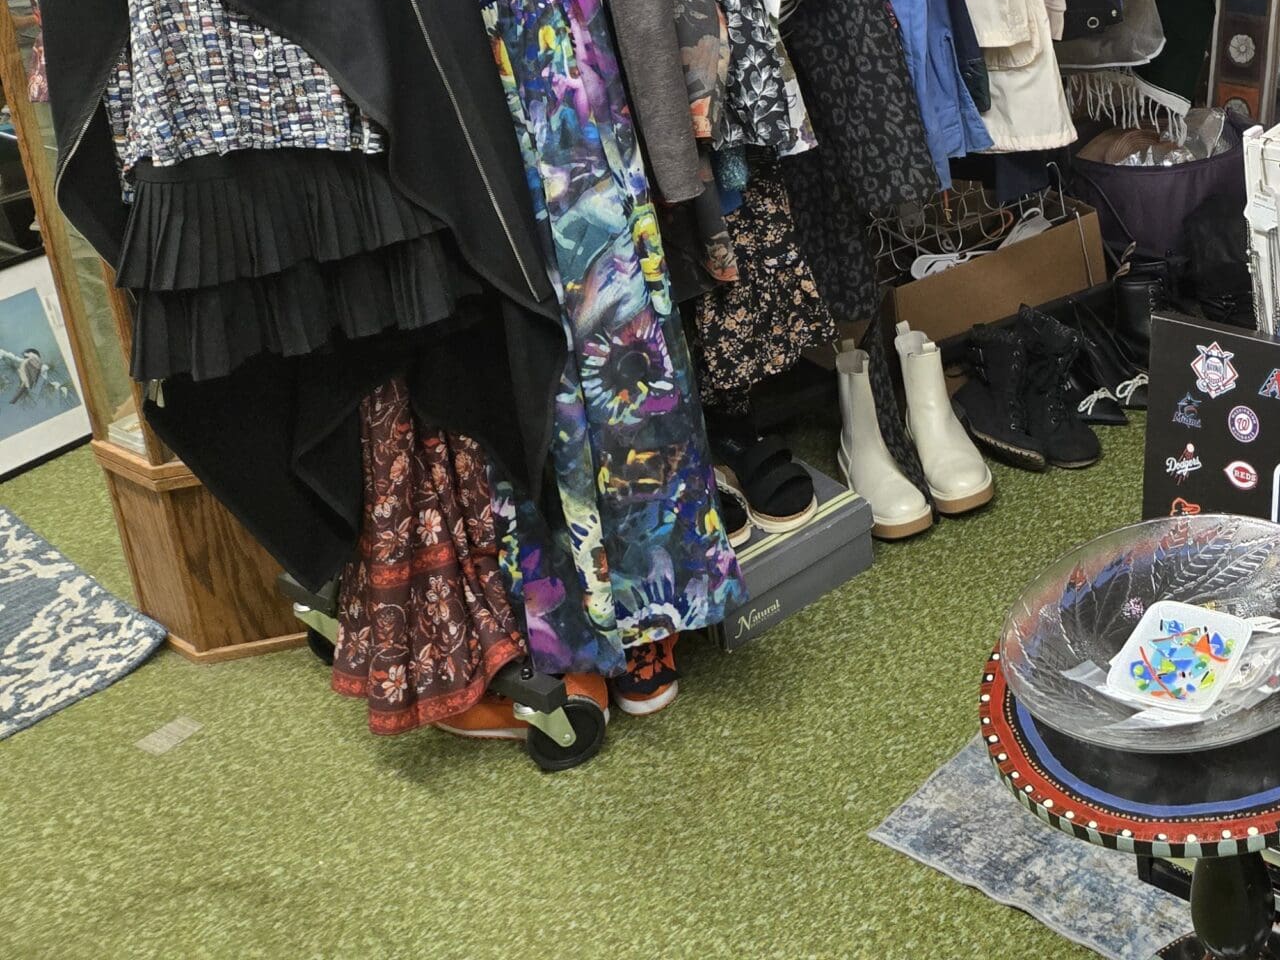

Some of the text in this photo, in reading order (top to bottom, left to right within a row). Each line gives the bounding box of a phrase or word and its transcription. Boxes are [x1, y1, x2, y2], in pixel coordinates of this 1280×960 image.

[1166, 455, 1202, 476] Dodgers
[1233, 467, 1258, 483] REDS
[734, 599, 781, 639] Natural
